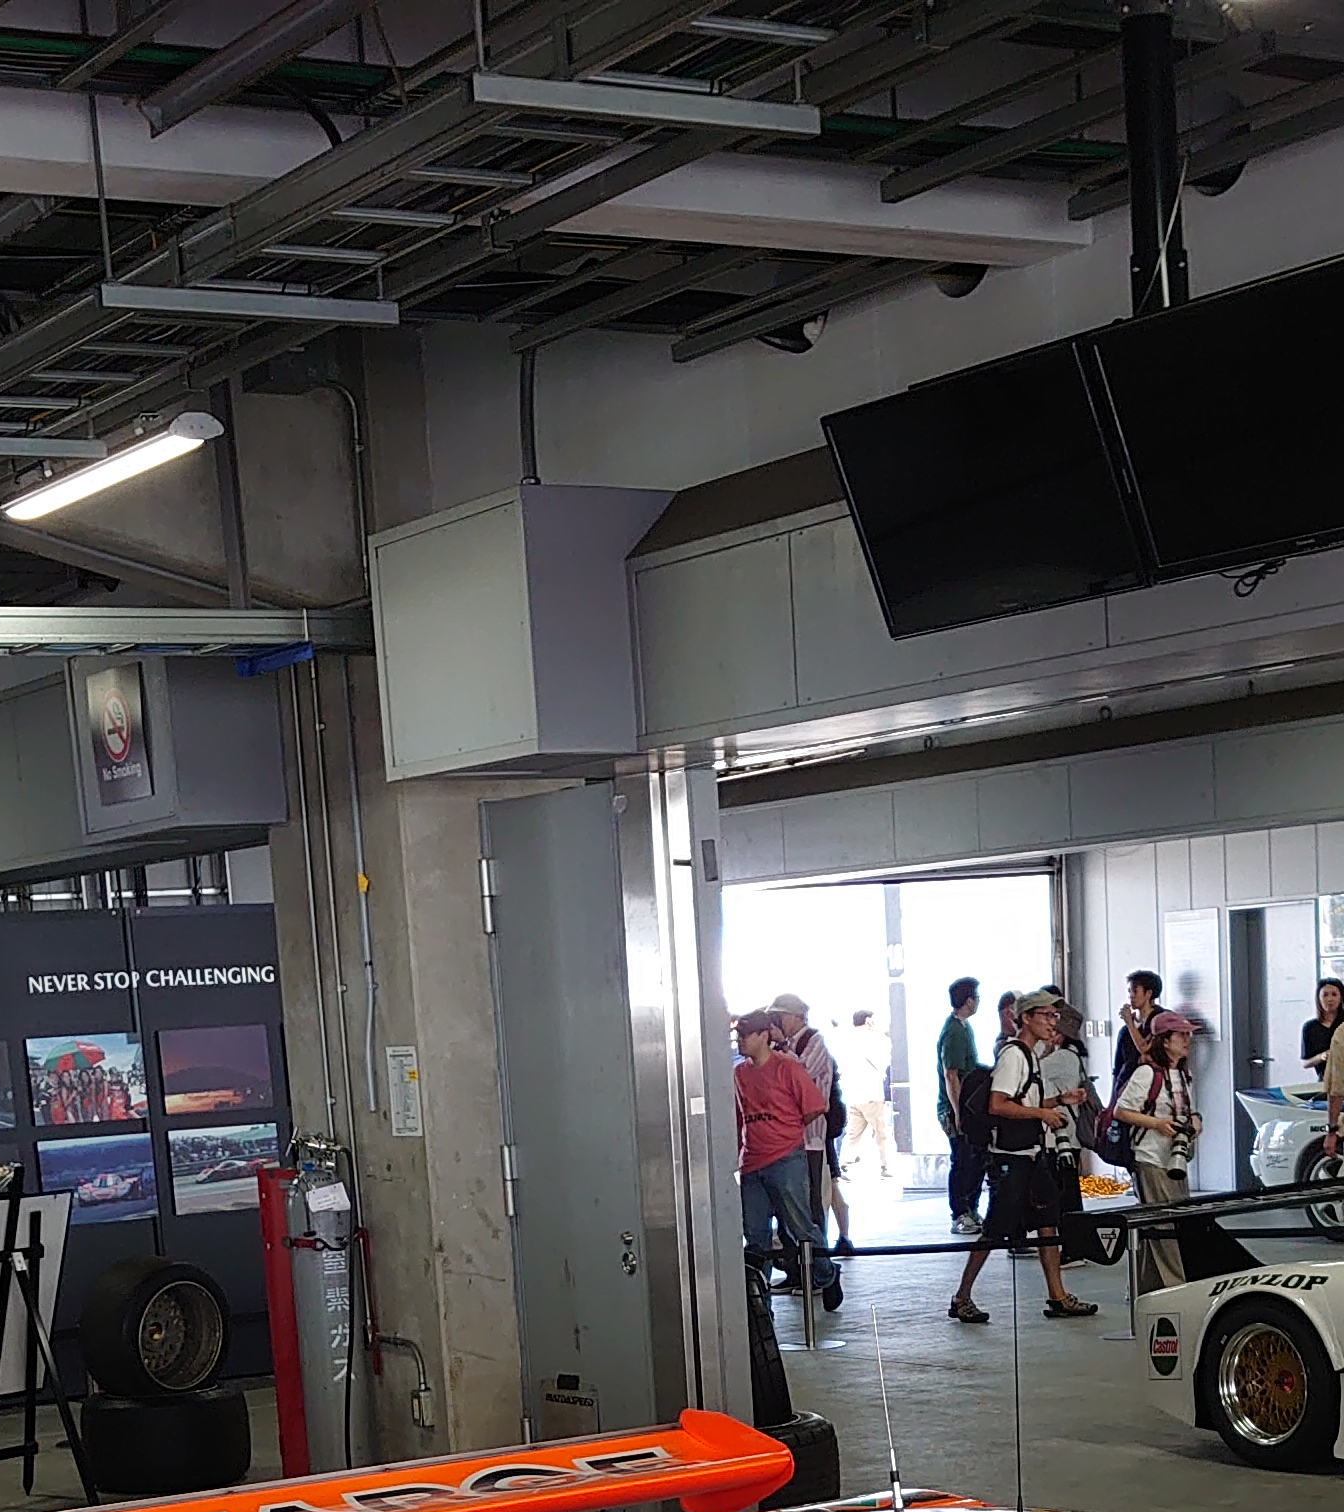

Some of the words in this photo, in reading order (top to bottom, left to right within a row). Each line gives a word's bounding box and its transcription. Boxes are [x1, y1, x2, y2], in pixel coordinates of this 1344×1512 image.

[103, 767, 112, 781] No
[112, 762, 143, 780] Smoking
[28, 973, 90, 994] NEVER
[93, 970, 140, 990] STOP
[145, 964, 276, 987] CHALLENGING
[1208, 1273, 1329, 1298] DUNLOP
[1152, 1337, 1179, 1355] Castrol
